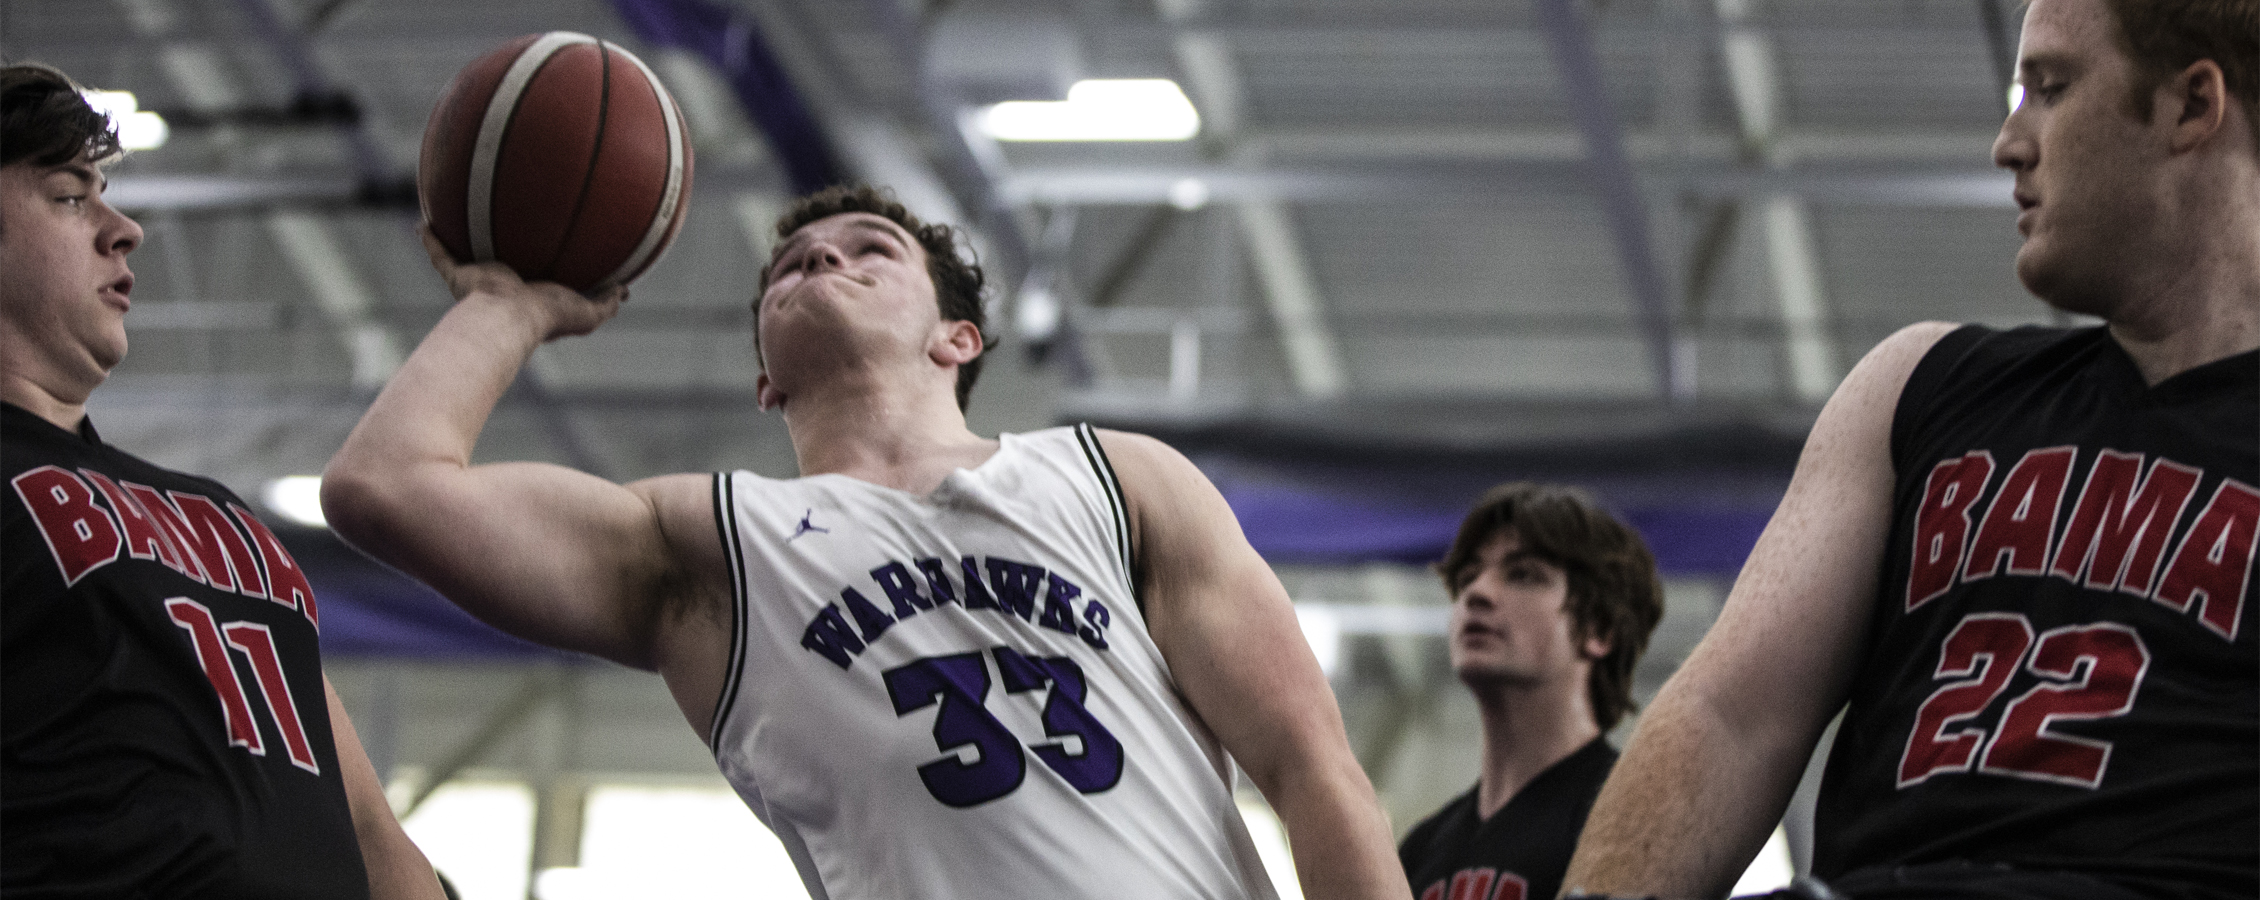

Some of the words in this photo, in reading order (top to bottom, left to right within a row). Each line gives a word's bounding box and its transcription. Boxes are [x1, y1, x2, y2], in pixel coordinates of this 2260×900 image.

[11, 464, 319, 635] BAMA
[1906, 445, 2260, 642] BAMA
[164, 596, 320, 776] 11
[880, 645, 1125, 809] 33
[1896, 611, 2151, 789] 22
